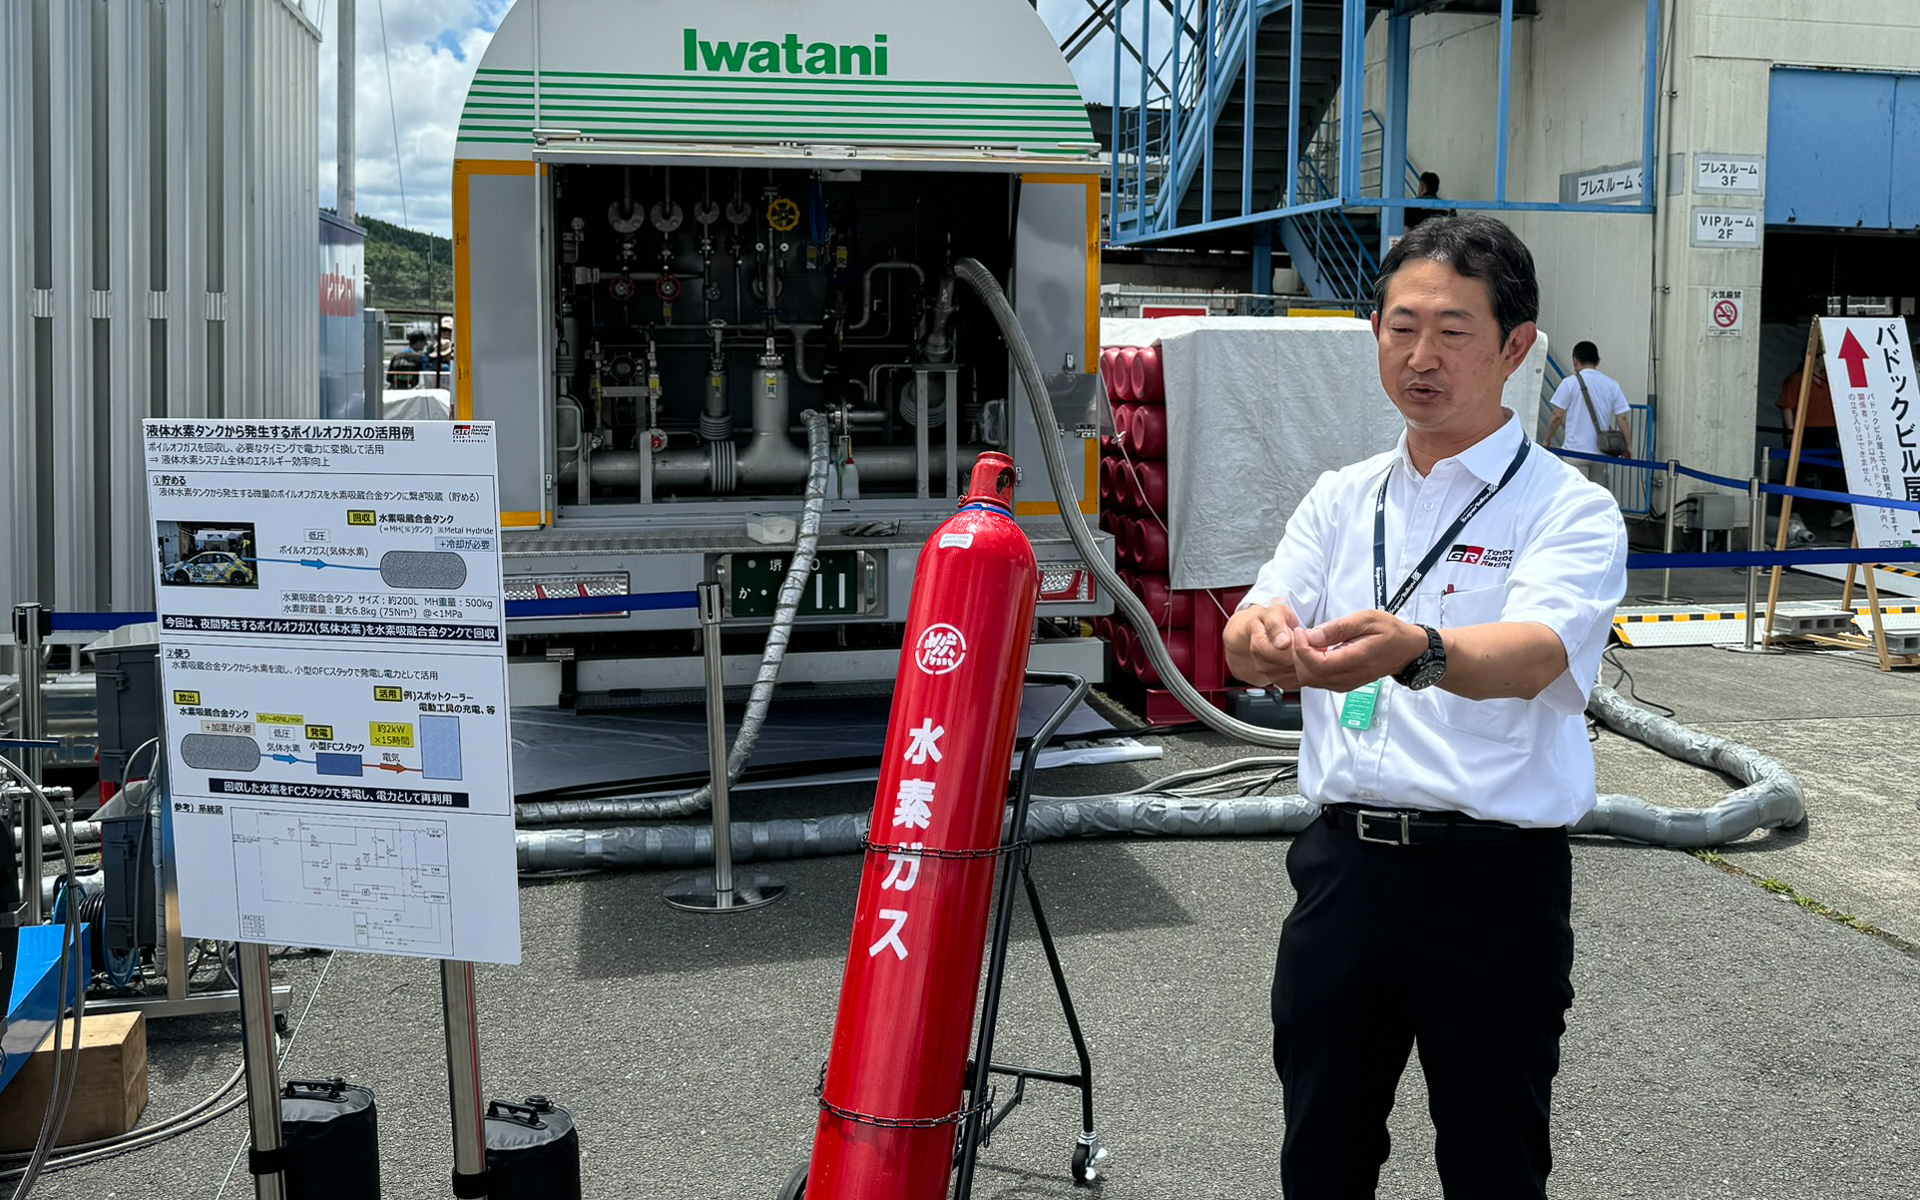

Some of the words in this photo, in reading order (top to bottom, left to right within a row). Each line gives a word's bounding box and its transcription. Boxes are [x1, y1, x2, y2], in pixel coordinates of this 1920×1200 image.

[683, 28, 888, 76] Iwatani
[1701, 162, 1758, 175] プレスルーム
[1580, 175, 1633, 196] プレスルーム
[1721, 176, 1738, 187] 3F
[1700, 215, 1755, 228] VIPルーム
[1717, 228, 1734, 240] 2F
[146, 424, 415, 440] 液体水素タンクから発生するボイルオフガスの活用例
[352, 513, 371, 523] 回収
[378, 513, 454, 525] 水素吸蔵合金タンク
[1447, 551, 1480, 563] GR
[769, 558, 783, 572] 堺
[738, 587, 752, 600] か
[919, 628, 961, 670] 燃
[378, 689, 397, 699] 活用
[868, 717, 945, 962] 水素ガス
